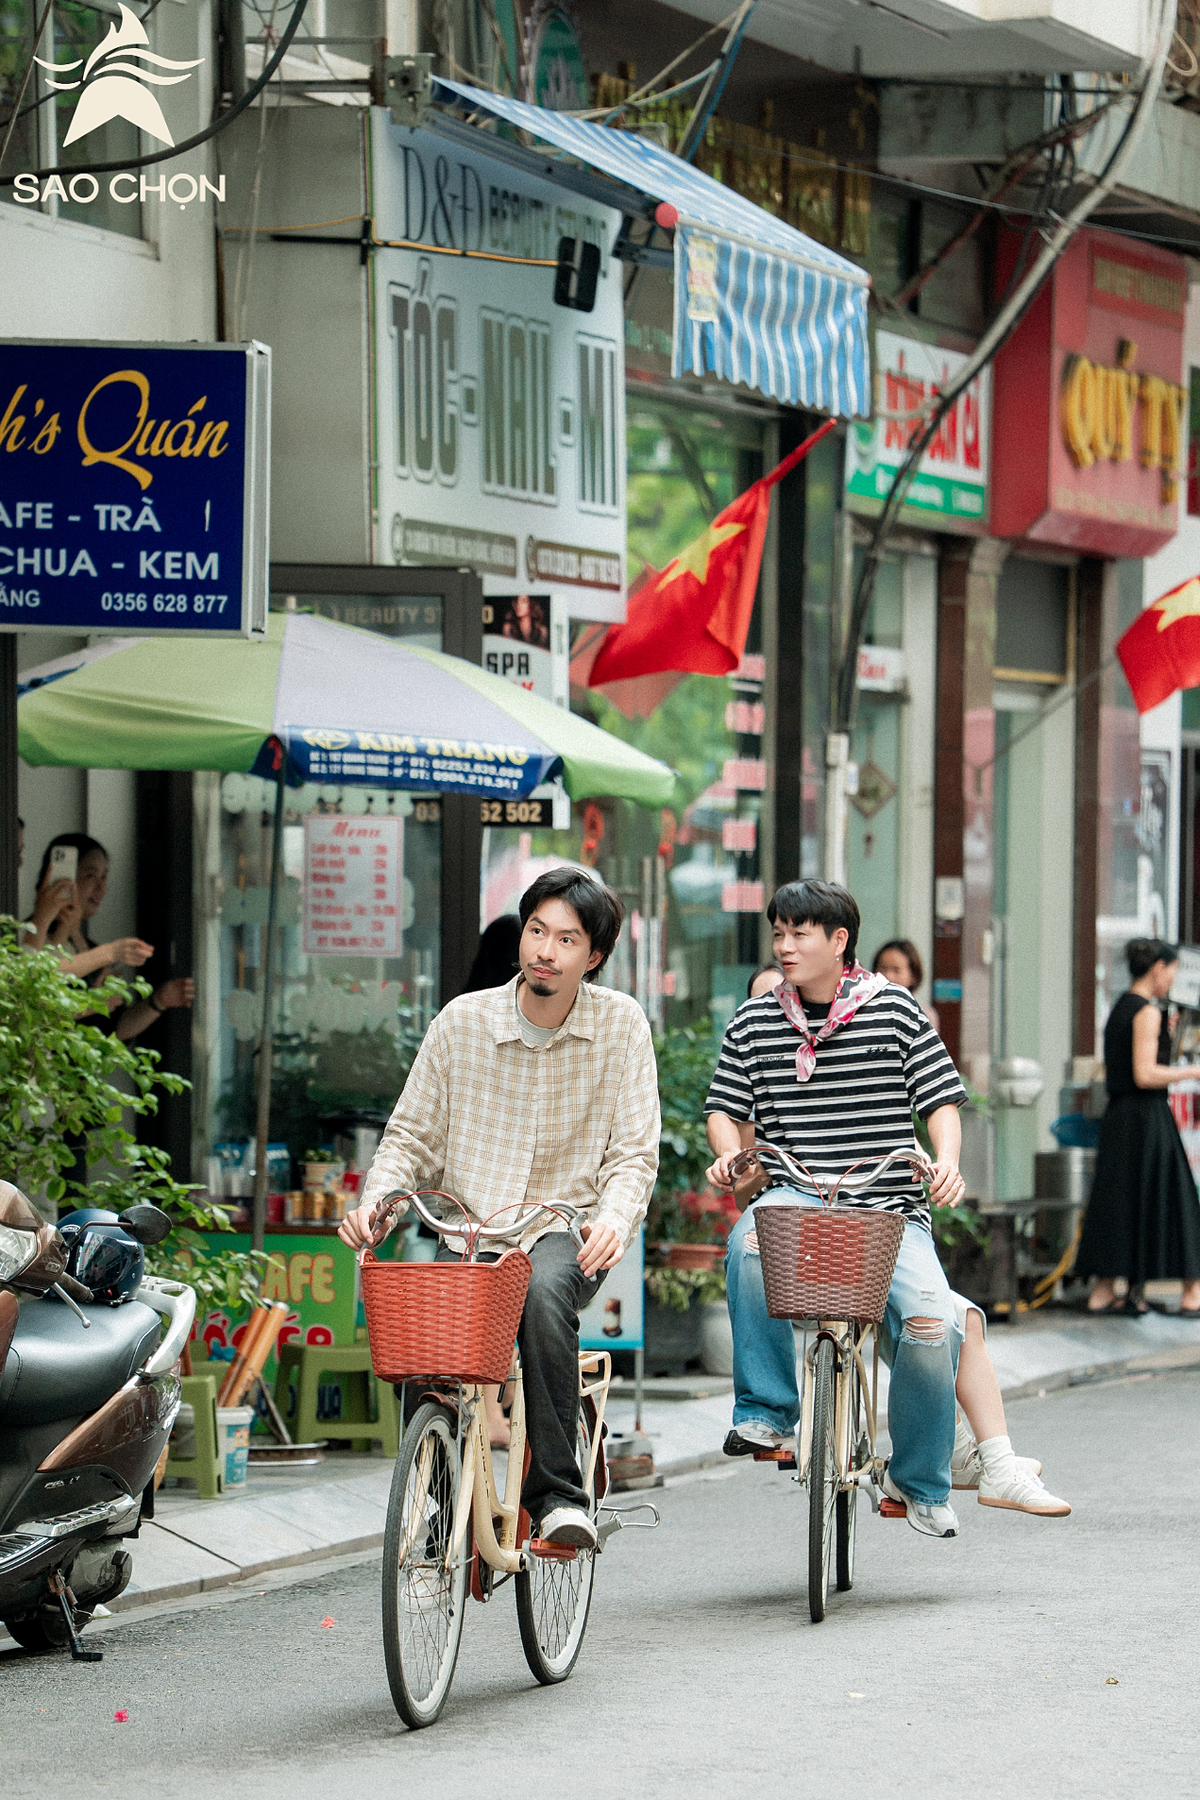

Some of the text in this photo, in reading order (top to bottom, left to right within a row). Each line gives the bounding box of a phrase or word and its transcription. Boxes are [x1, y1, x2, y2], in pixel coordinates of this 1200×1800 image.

[400, 145, 484, 252] D&D
[77, 370, 229, 490] Quán
[93, 497, 161, 532] TRÀ
[139, 551, 219, 580] KEM
[101, 592, 147, 612] 0356
[152, 594, 187, 613] 628
[193, 595, 228, 613] 877
[486, 652, 529, 676] SPA
[356, 731, 417, 754] KIM
[420, 737, 530, 766] TRANG
[506, 801, 542, 823] 502
